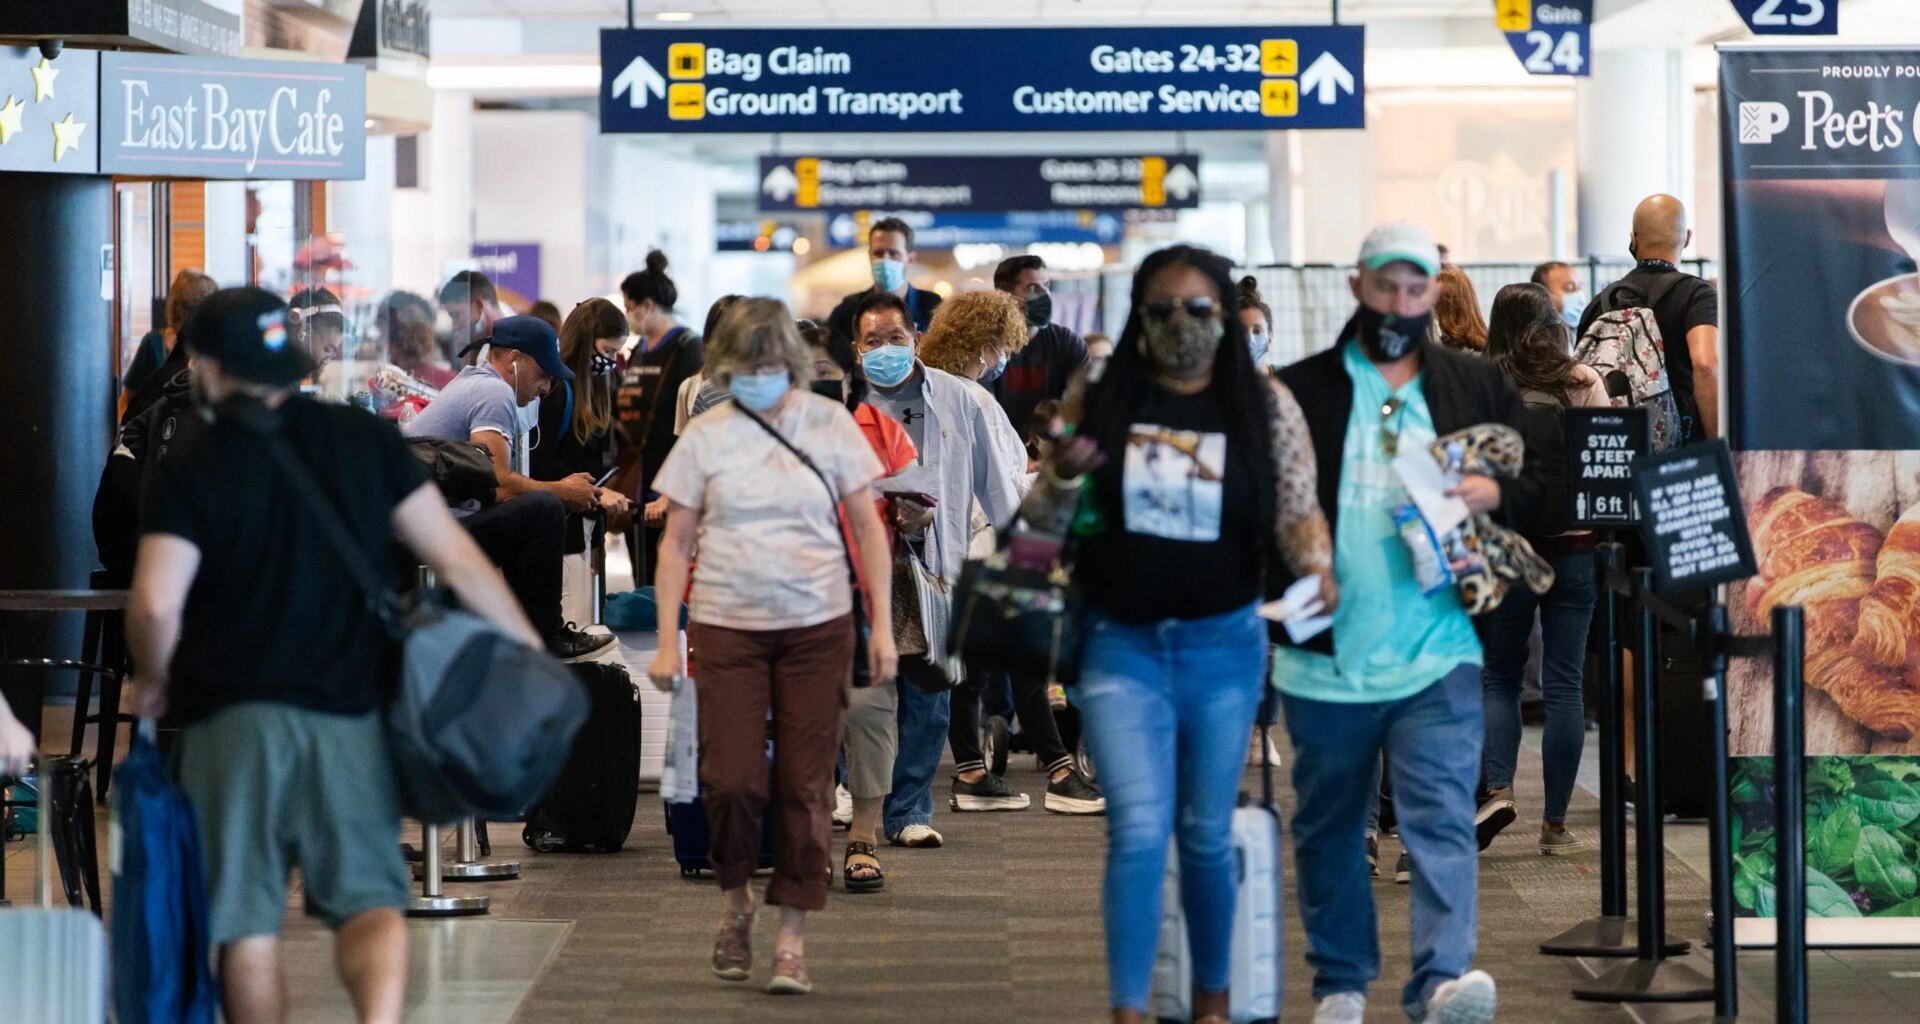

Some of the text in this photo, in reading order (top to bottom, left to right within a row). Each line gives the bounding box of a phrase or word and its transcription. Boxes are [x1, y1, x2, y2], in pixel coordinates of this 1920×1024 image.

[1536, 4, 1583, 24] Gate
[706, 46, 851, 81] Bag Claim
[1090, 44, 1260, 74] Gates 24-32
[1525, 30, 1584, 73] 24
[1822, 65, 1890, 78] PROUDLY
[705, 85, 964, 120] Ground Transport
[1013, 83, 1260, 114] Customer Service
[121, 80, 344, 173] East Bay Cafe
[1797, 90, 1903, 152] Peet's
[819, 159, 907, 185] Bag Claim
[820, 183, 971, 207] Ground Transport
[1588, 435, 1628, 448] STAY
[1581, 450, 1635, 463] 6 FEET
[1651, 473, 1718, 500] IF YOU ARE
[1651, 484, 1725, 512] ILL OR HAVE
[1596, 496, 1622, 512] 6 ft
[1657, 497, 1724, 522] SYMPTOMS
[1655, 506, 1730, 535] CONSISTENT
[1680, 523, 1712, 539] WITH
[1669, 541, 1735, 566] PLEASE DO
[1671, 552, 1739, 578] NOT ENTER
